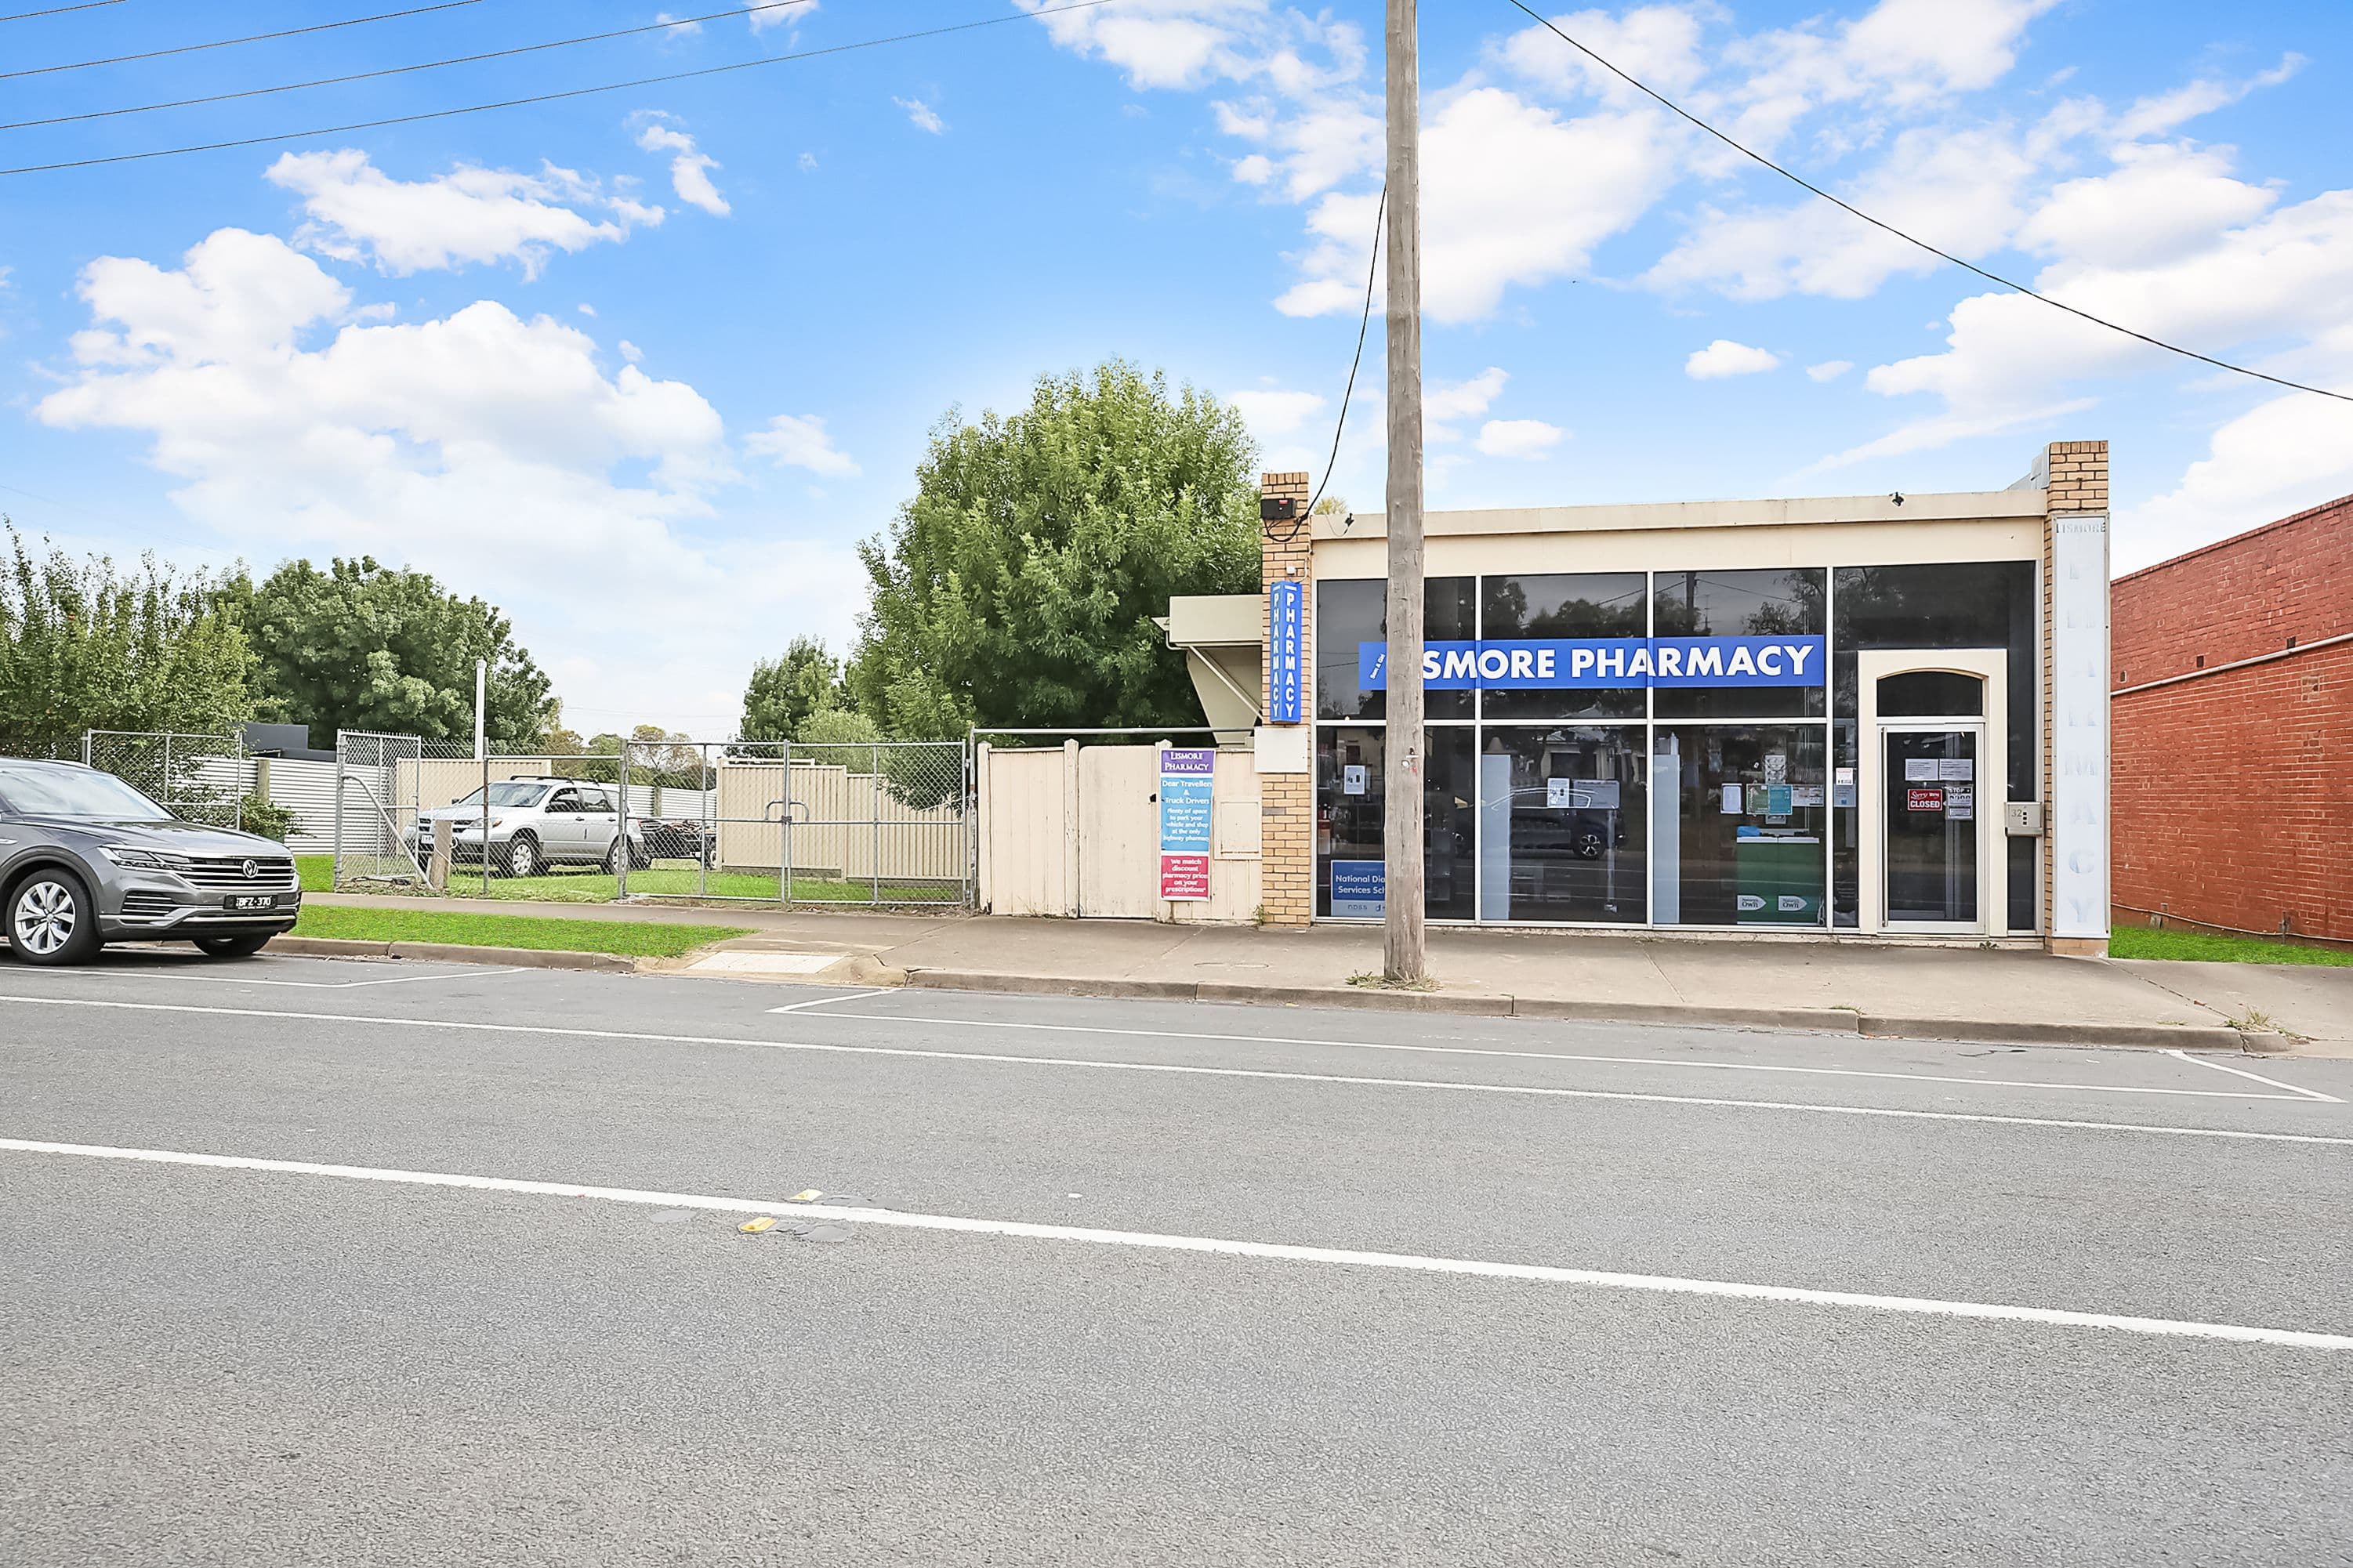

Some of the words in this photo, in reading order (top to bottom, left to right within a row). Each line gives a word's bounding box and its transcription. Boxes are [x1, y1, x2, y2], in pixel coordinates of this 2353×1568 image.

[1285, 592, 1296, 718] PHARMACY
[1423, 649, 1556, 679] SMORE
[1571, 645, 1815, 679] PHARMACY
[1170, 751, 1203, 760] LISMORE
[1165, 762, 1209, 771] PHARMACY
[2011, 809, 2022, 817] 32
